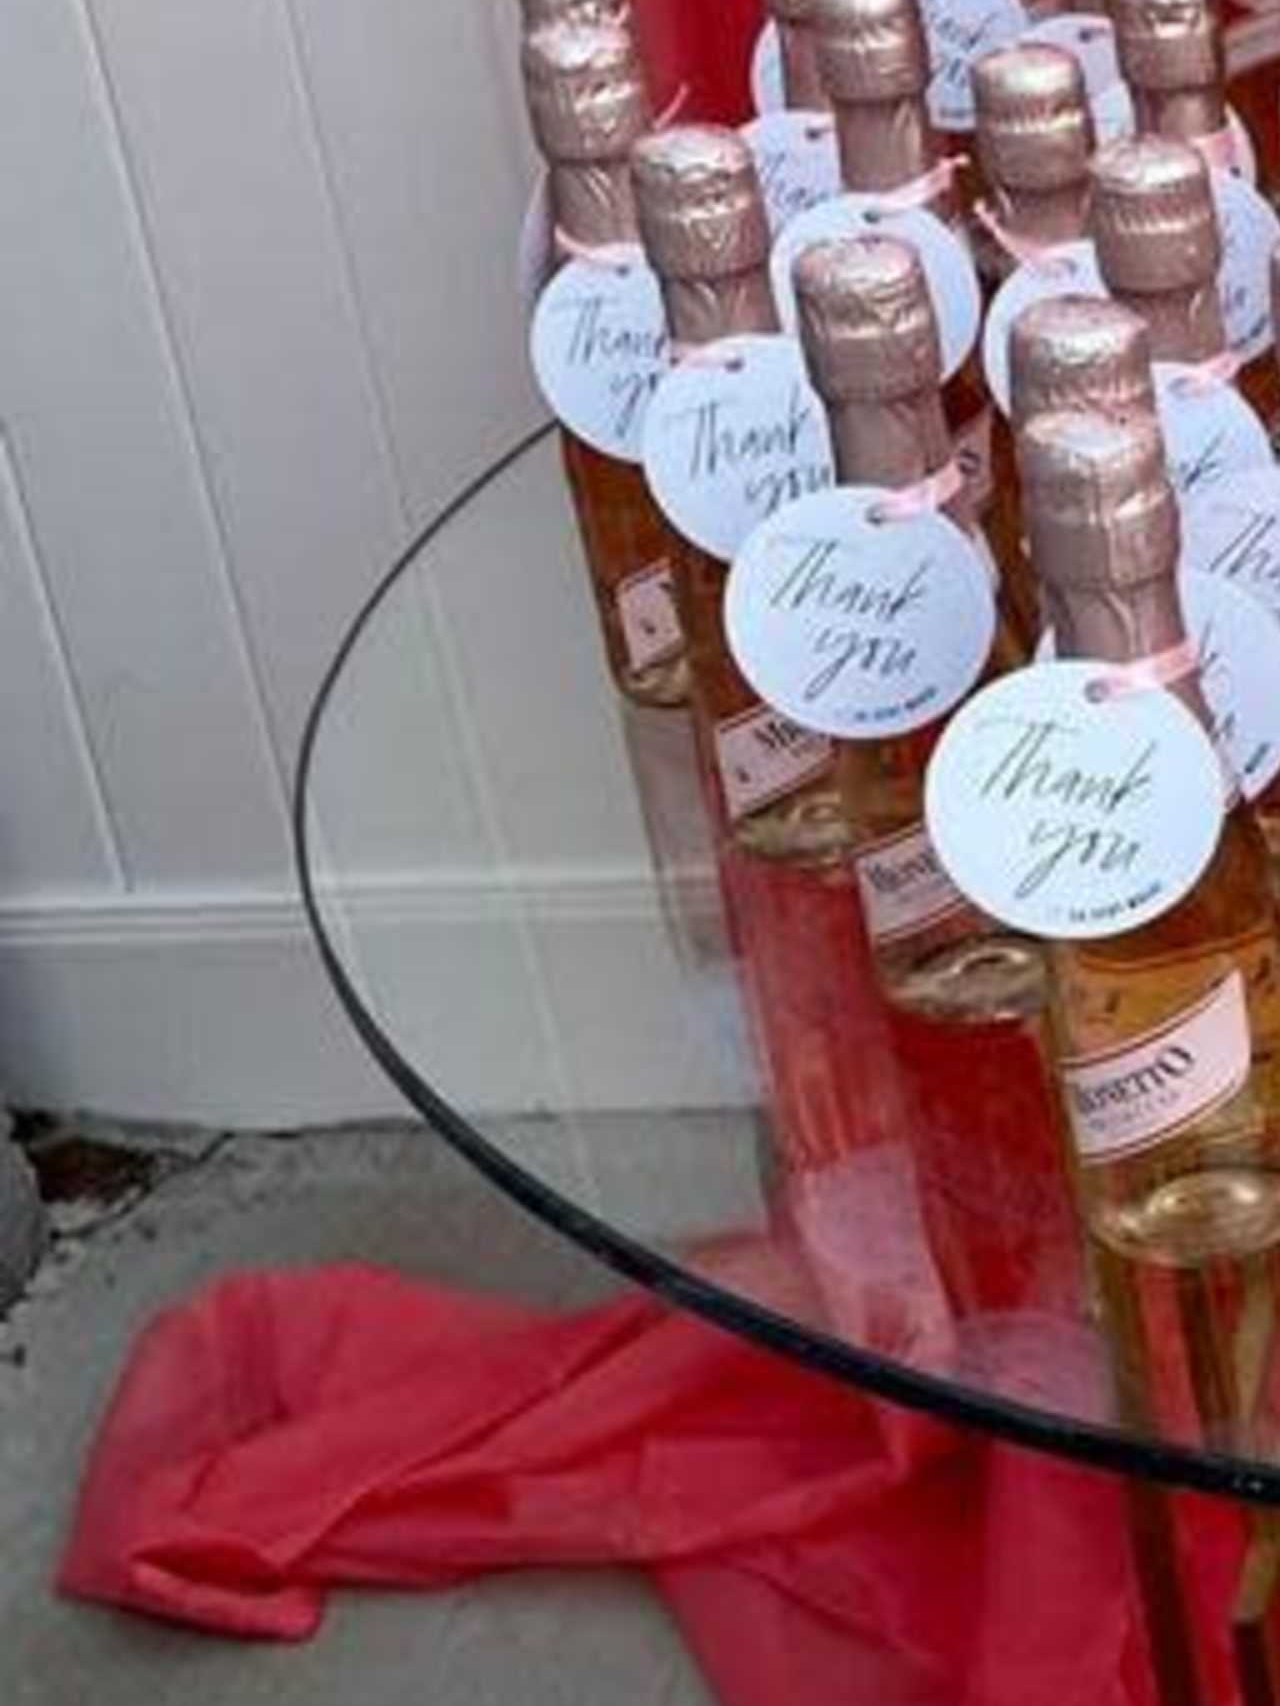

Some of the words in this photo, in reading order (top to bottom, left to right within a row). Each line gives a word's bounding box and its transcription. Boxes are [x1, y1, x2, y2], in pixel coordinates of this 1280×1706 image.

[671, 388, 811, 479] Thank
[748, 534, 936, 620] Thank
[805, 624, 918, 701] you
[974, 717, 1157, 811] Thank
[1014, 815, 1140, 899] you
